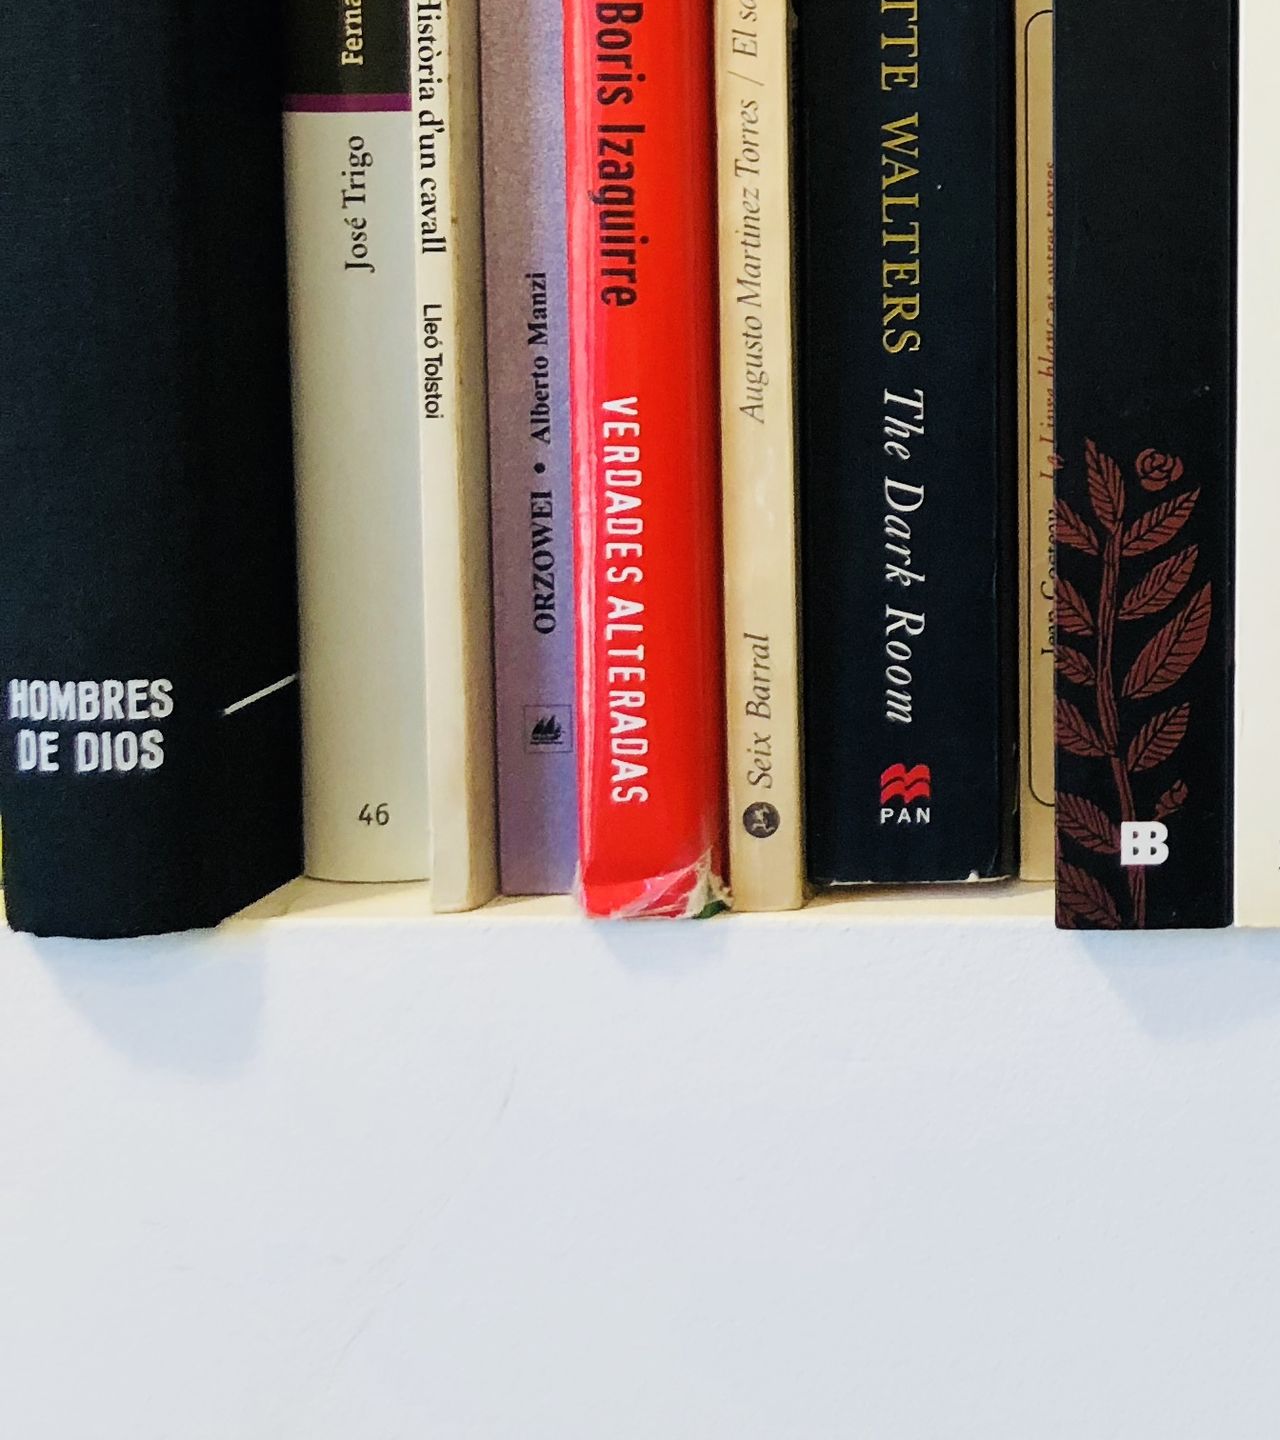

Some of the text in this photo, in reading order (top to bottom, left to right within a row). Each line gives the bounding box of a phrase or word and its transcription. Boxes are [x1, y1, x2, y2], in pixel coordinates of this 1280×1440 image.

[732, 23, 758, 59] El
[418, 109, 444, 170] d'un
[587, 2, 649, 307] Boris Izaguirre
[734, 100, 760, 176] Torres
[342, 135, 375, 273] José Trigo
[419, 177, 447, 254] cavall
[881, 112, 922, 354] WALTERS
[423, 304, 444, 419] Lleó Tolstoi
[739, 315, 768, 425] Augusto
[526, 272, 556, 635] ORZOWEI Alberto Manzi
[882, 387, 924, 459] The
[884, 476, 925, 588] Dark
[601, 397, 649, 805] VERDADES ALTERADAS
[9, 679, 174, 720] HOMBRES
[743, 633, 772, 791] Seix Barral
[884, 604, 926, 723] Room
[17, 730, 165, 772] DE DIOS
[358, 803, 390, 826] 46
[880, 809, 931, 824] PAN
